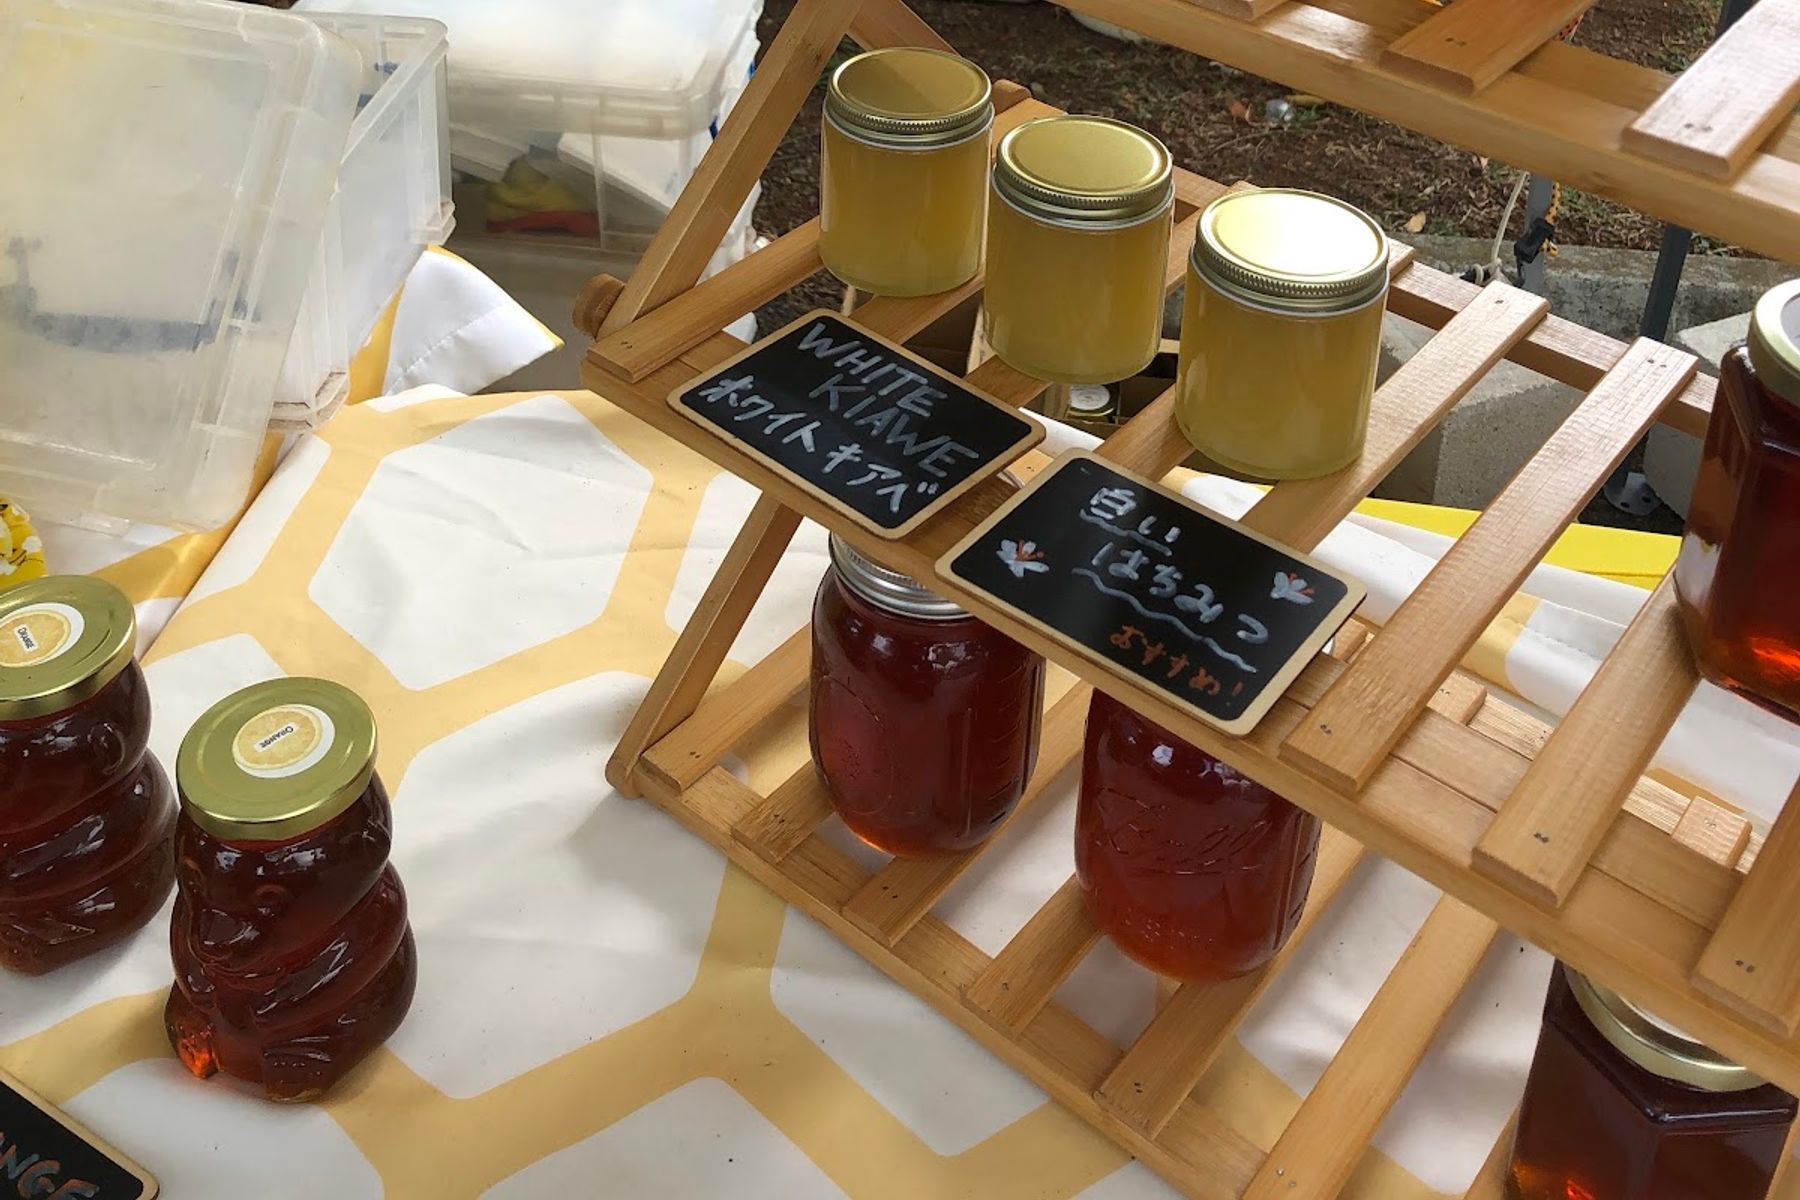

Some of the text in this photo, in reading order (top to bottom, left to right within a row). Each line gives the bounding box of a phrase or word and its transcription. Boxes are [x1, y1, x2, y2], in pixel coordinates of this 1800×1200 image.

[797, 322, 949, 417] WHITE
[808, 373, 980, 478] KIAWE
[1092, 542, 1269, 644] はちみつ
